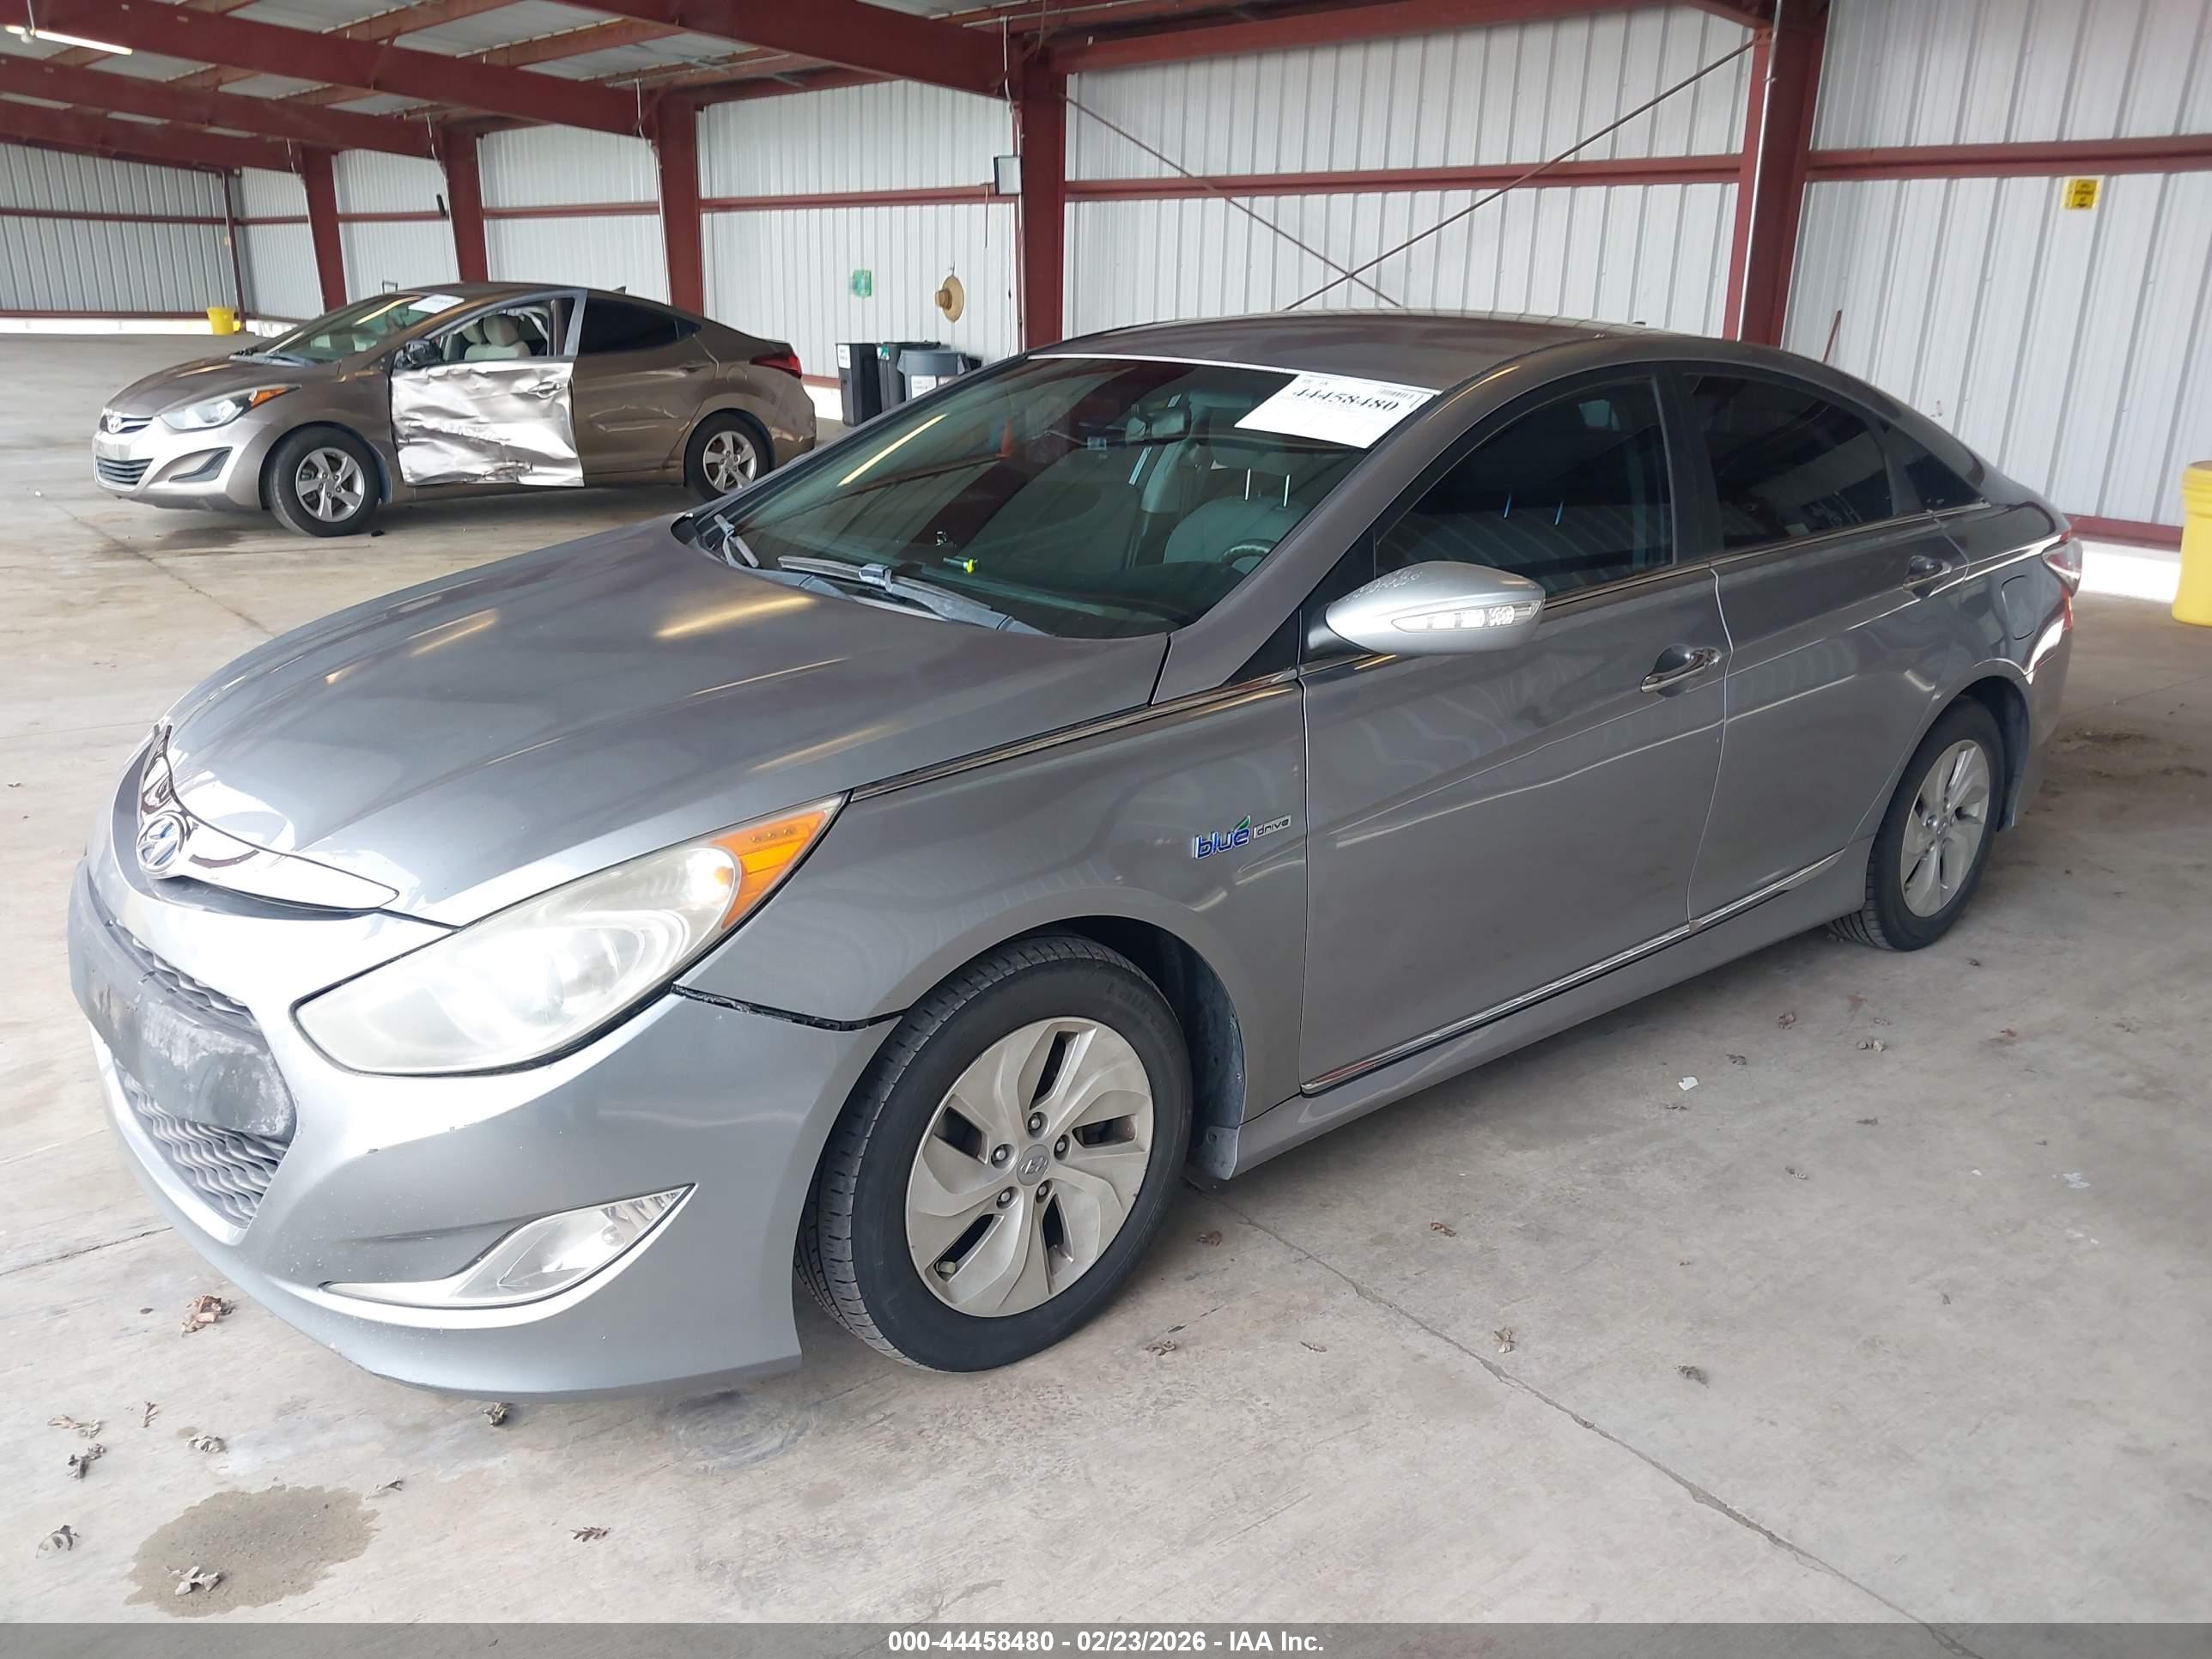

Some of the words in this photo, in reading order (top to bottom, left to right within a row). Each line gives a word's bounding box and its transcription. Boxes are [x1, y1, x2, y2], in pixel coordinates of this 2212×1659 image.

[1291, 388, 1400, 412] 44458480
[1194, 822, 1250, 859] blue
[1256, 817, 1290, 836] drive
